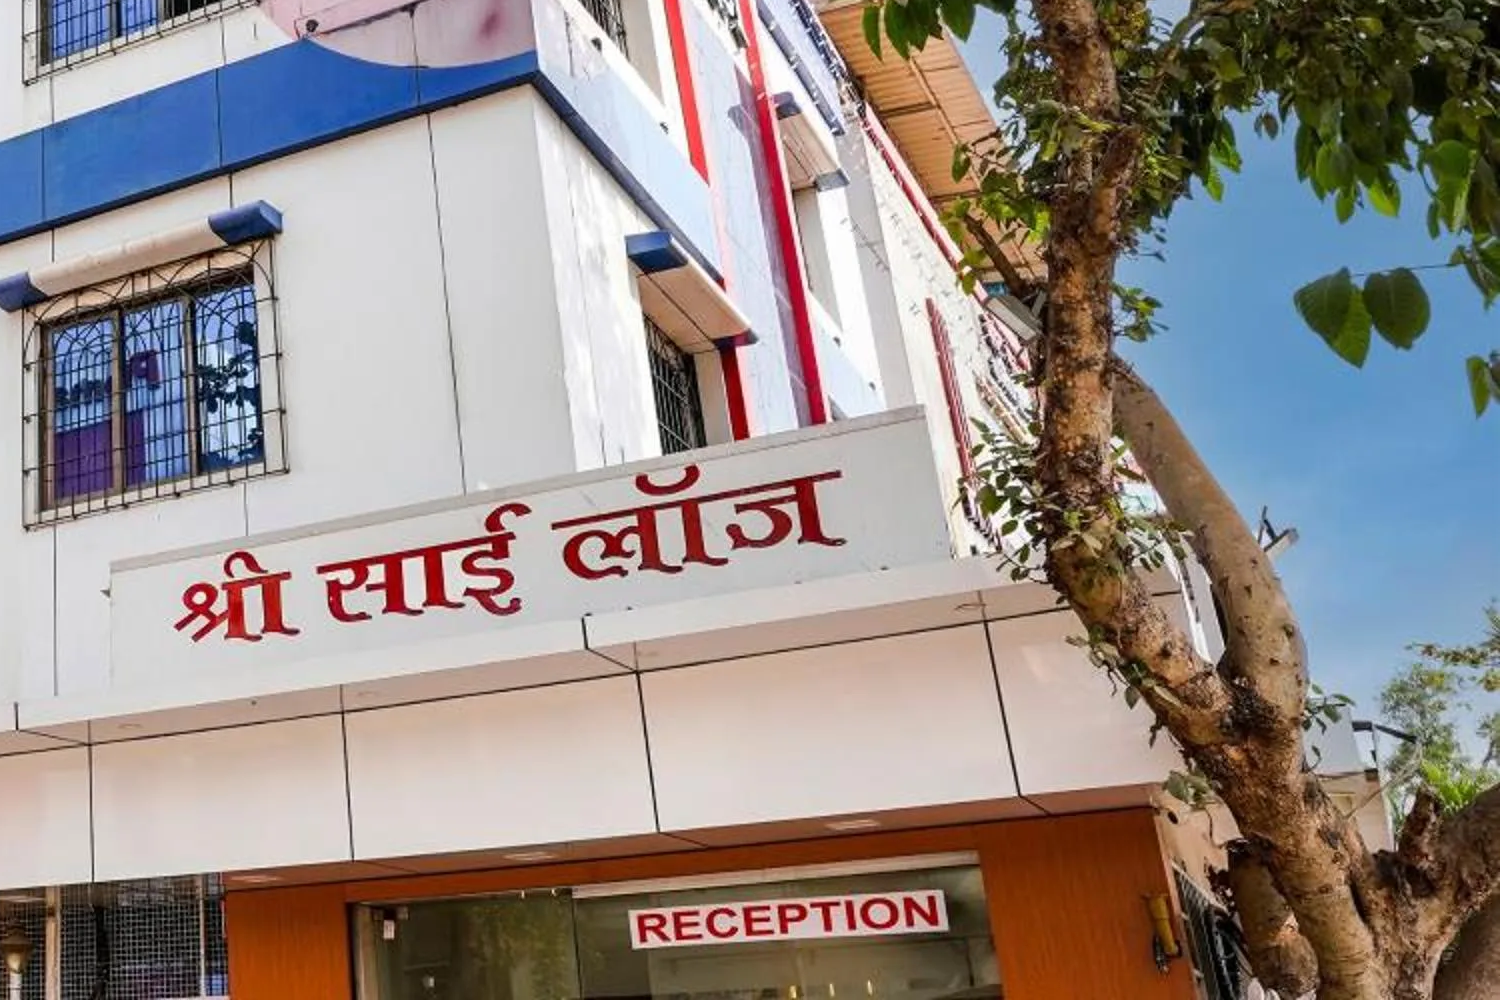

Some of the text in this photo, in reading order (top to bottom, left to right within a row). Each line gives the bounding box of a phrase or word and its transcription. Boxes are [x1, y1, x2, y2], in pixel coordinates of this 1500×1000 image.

[172, 465, 847, 642] श्री साई लॉज
[635, 894, 941, 944] RECEPTION
